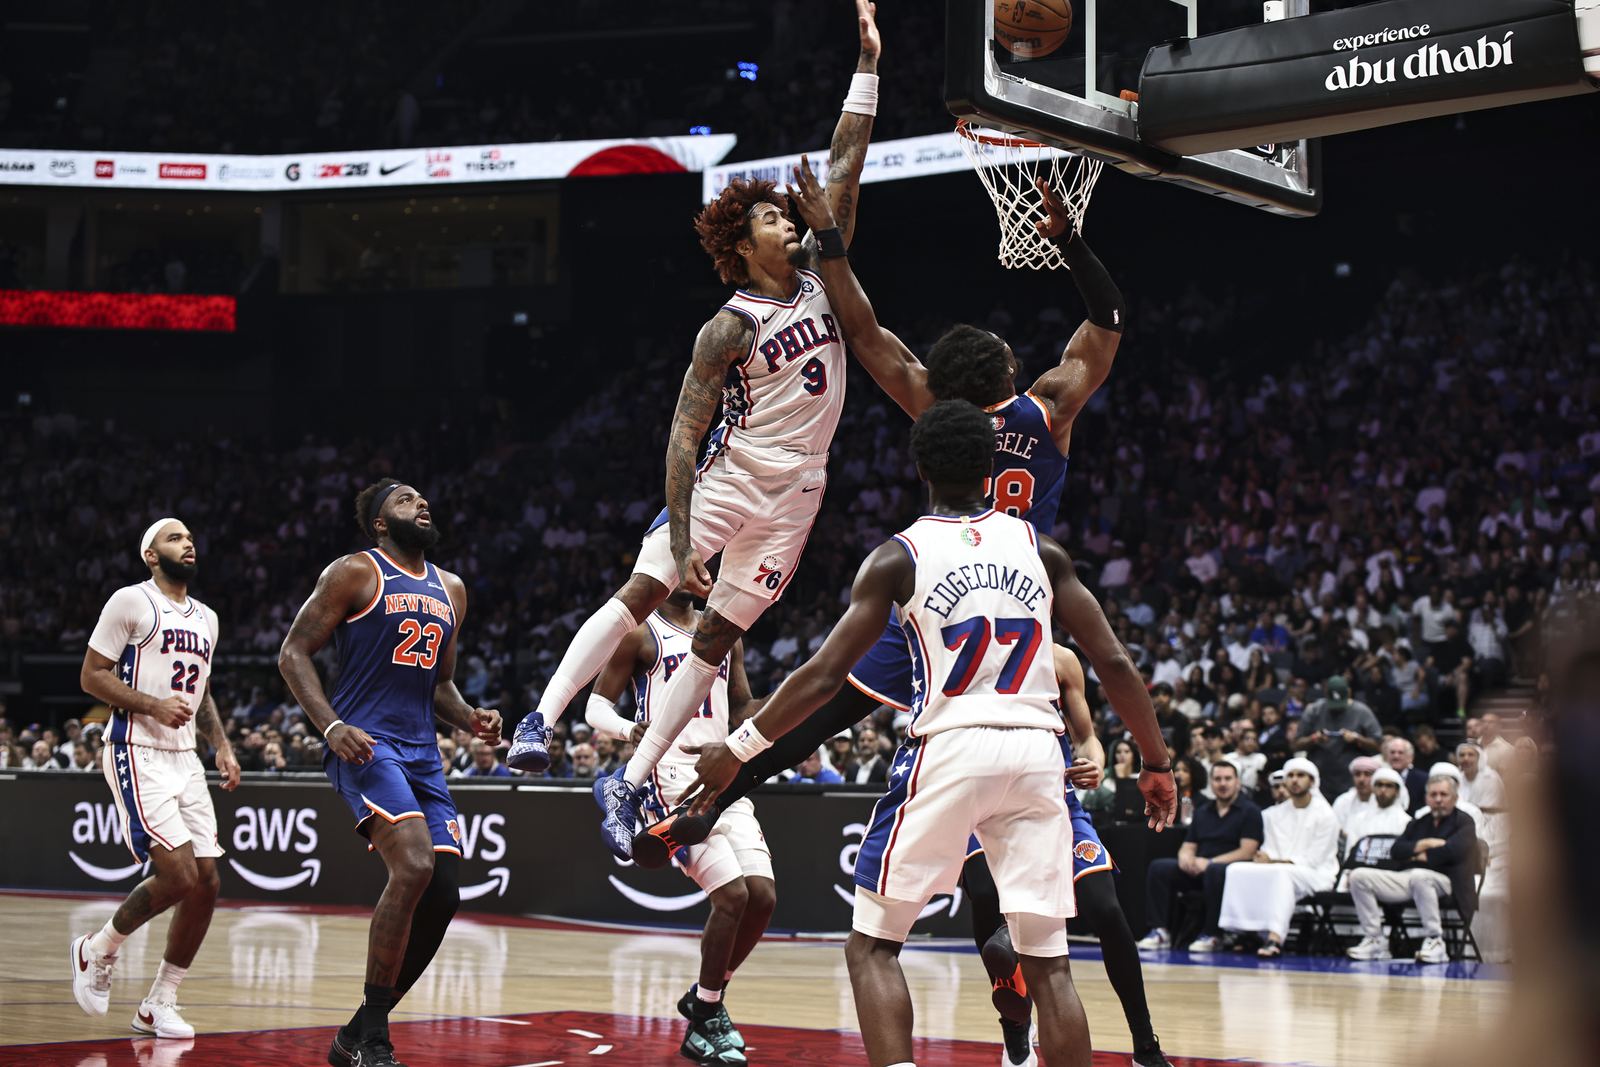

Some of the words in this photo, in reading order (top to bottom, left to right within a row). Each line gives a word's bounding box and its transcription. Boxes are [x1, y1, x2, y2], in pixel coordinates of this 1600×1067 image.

[1324, 55, 1397, 91] abu
[801, 356, 828, 397] 9
[385, 593, 419, 615] NEW
[419, 594, 452, 626] YORK
[923, 563, 1047, 620] EDGECOMBE
[392, 618, 444, 670] 23
[940, 616, 1043, 698] 77
[171, 660, 200, 694] 22
[72, 801, 123, 845] aw
[233, 805, 318, 855] aws
